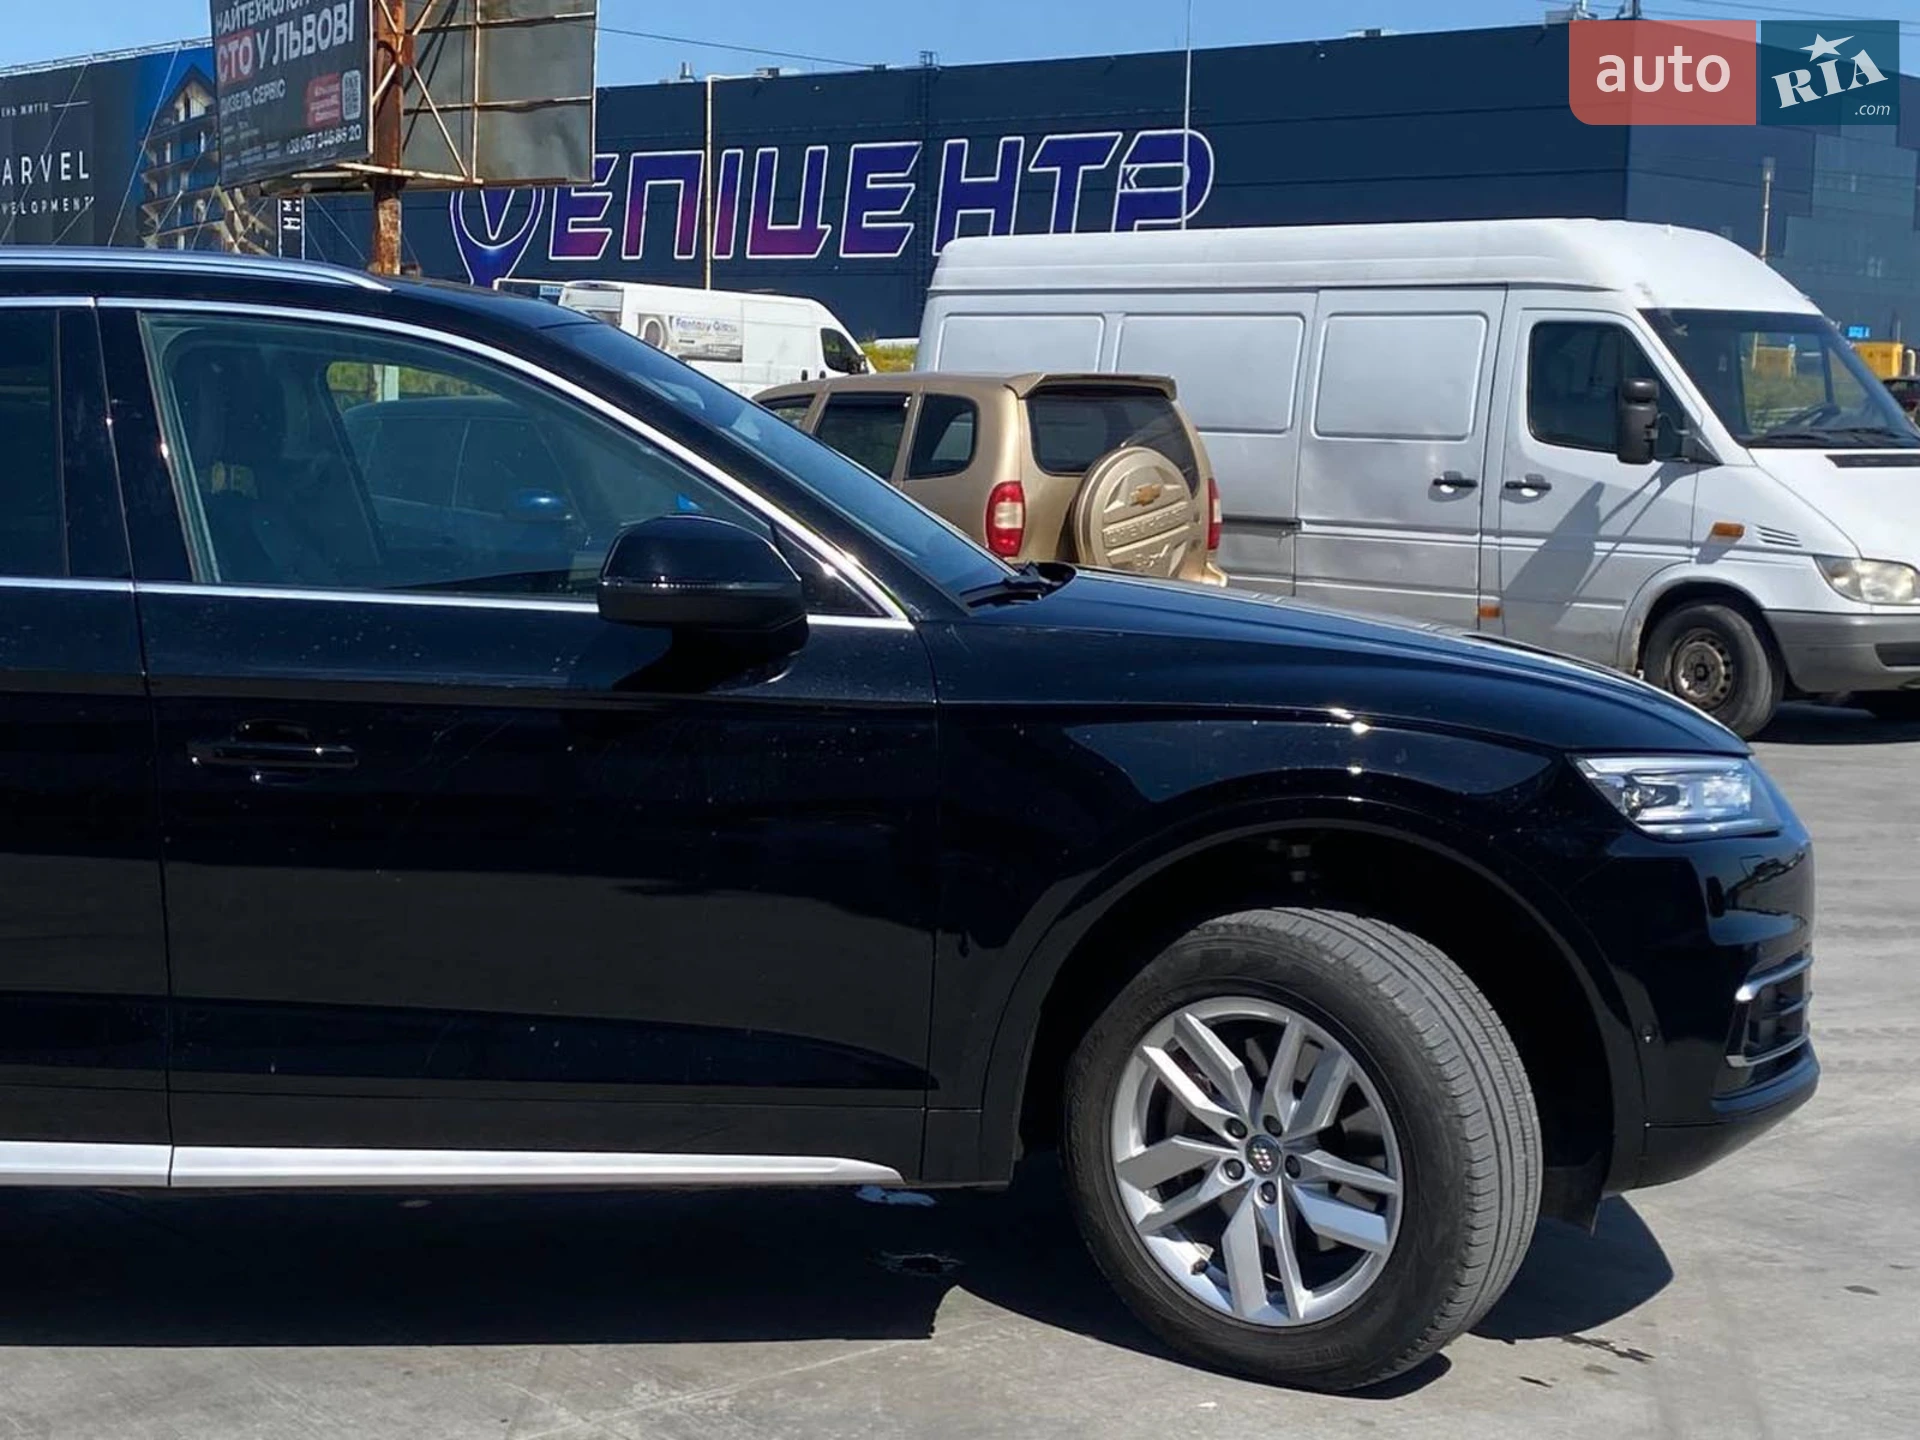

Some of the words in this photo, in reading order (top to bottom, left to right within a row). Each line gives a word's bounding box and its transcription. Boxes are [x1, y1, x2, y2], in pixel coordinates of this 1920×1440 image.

[217, 36, 253, 83] СТО
[256, 29, 270, 69] У
[272, 0, 355, 66] ЛЬВОВІ
[548, 127, 1216, 261] ЕПІЦЕНТР
